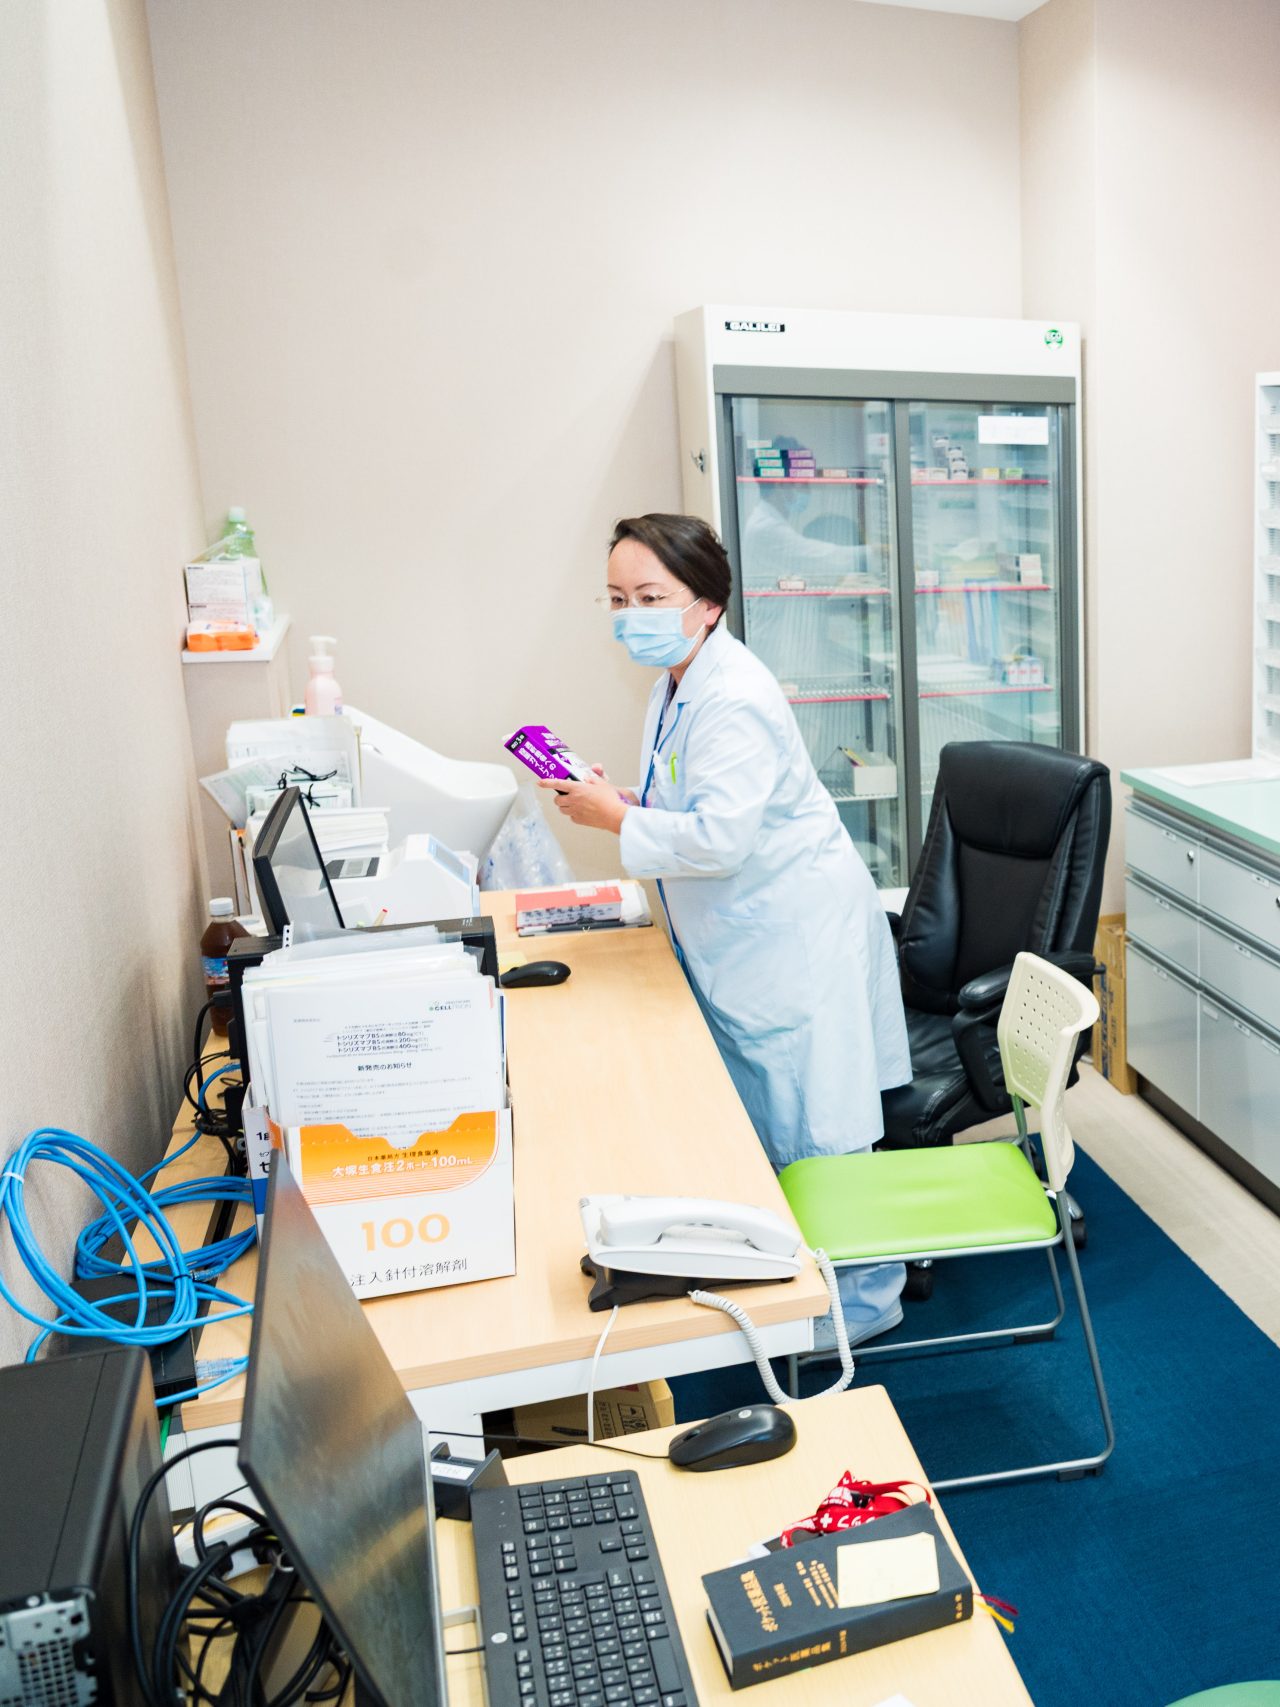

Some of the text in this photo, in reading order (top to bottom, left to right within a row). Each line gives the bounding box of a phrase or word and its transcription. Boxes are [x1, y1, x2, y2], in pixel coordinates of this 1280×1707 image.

[357, 1061, 413, 1072] 新発売のお知らせ
[360, 1212, 451, 1253] 100
